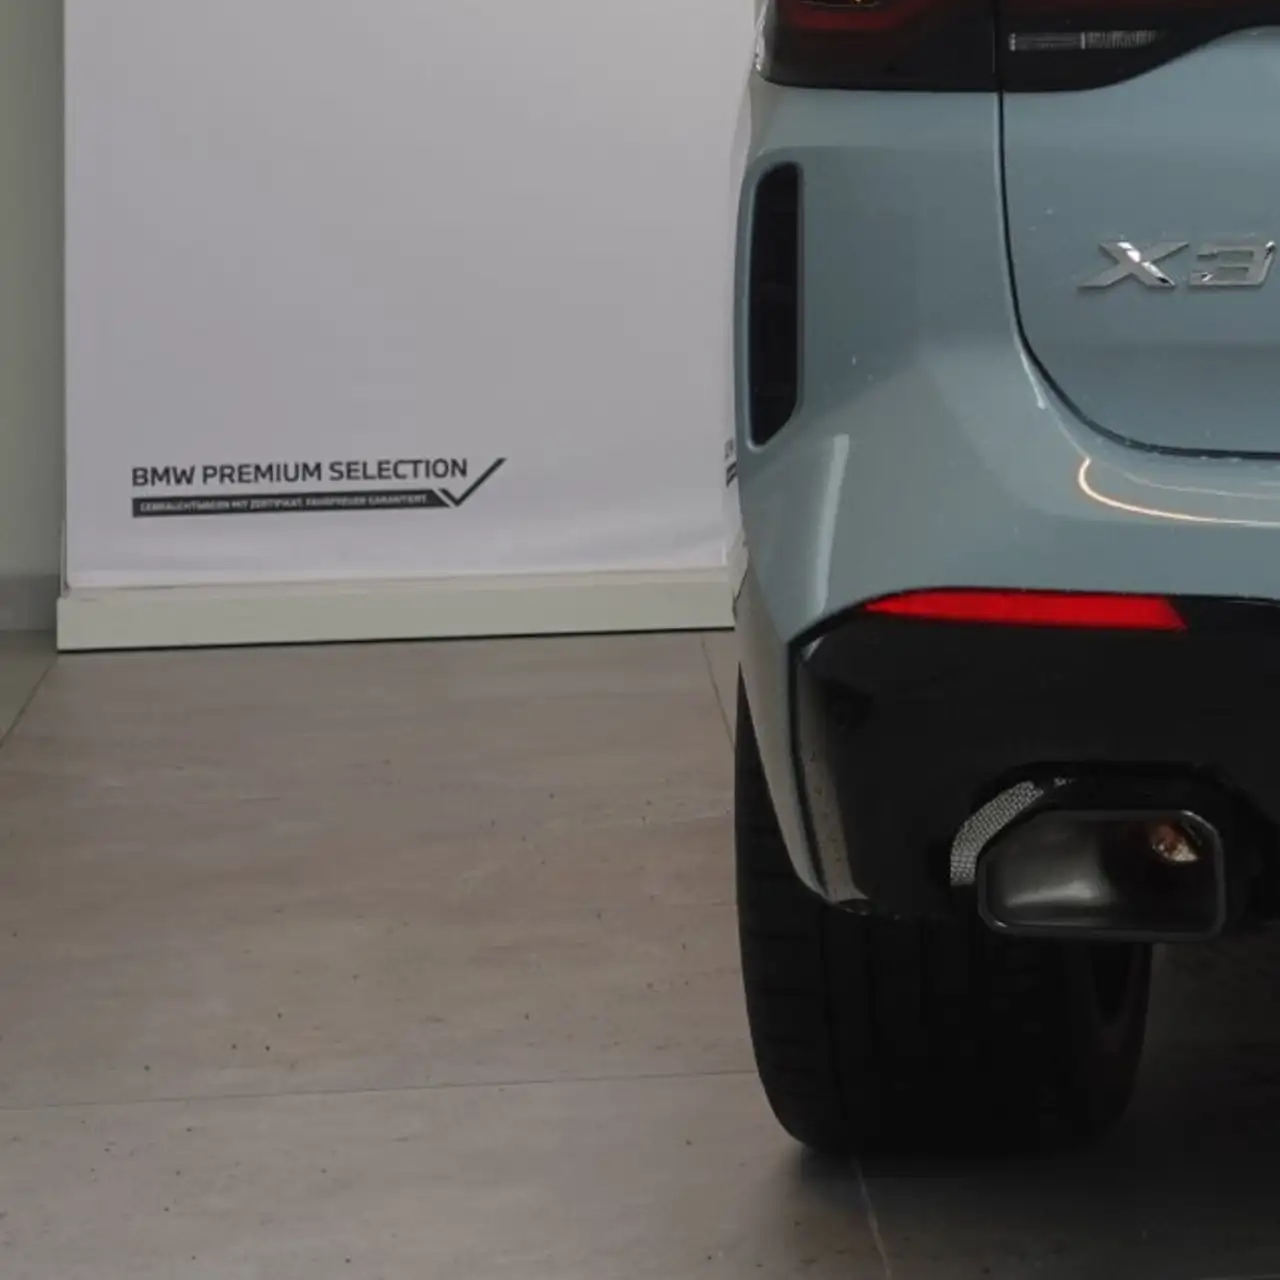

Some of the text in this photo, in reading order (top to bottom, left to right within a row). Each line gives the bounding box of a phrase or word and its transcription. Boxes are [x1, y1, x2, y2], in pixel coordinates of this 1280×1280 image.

[1077, 240, 1278, 288] X3
[131, 457, 468, 488] BMW PREMIUM SELECTION
